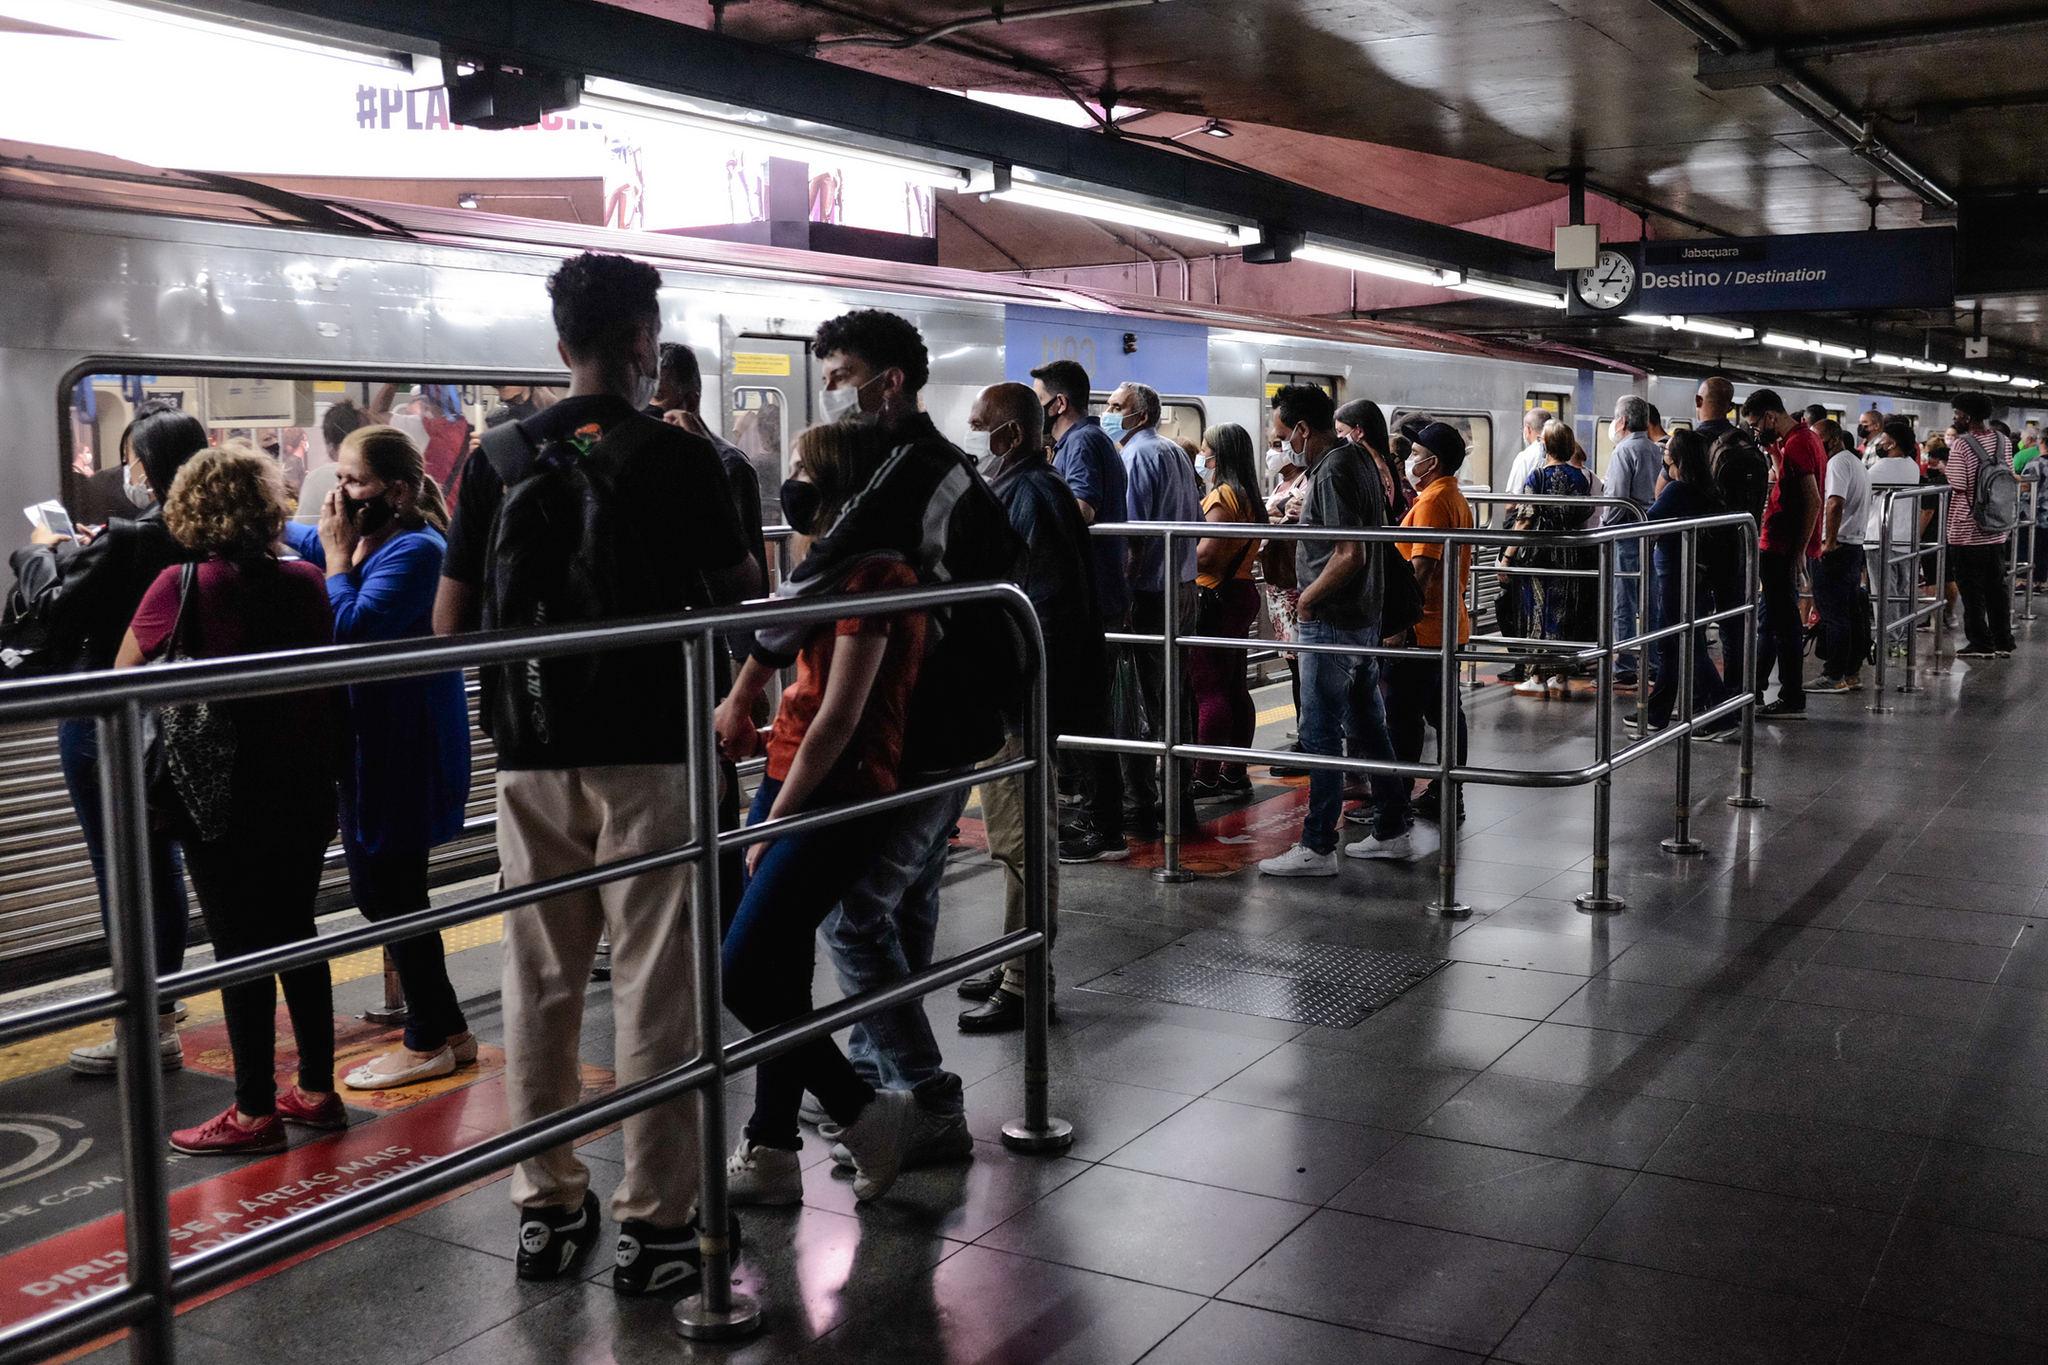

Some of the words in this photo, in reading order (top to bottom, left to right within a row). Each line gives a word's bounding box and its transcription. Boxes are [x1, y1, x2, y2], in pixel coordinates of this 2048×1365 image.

[1681, 248, 1739, 259] Jabaquara
[1602, 257, 1610, 266] 12
[1586, 268, 1595, 278] 10
[1621, 265, 1627, 274] 2
[1583, 278, 1589, 286] 9
[1625, 275, 1630, 284] 3
[1641, 270, 1721, 289] Destino
[1724, 271, 1733, 286] /
[1735, 268, 1827, 285] Destination
[212, 1211, 243, 1225] A
[238, 1172, 340, 1213] ÁREAS
[335, 1145, 412, 1175] MAIS
